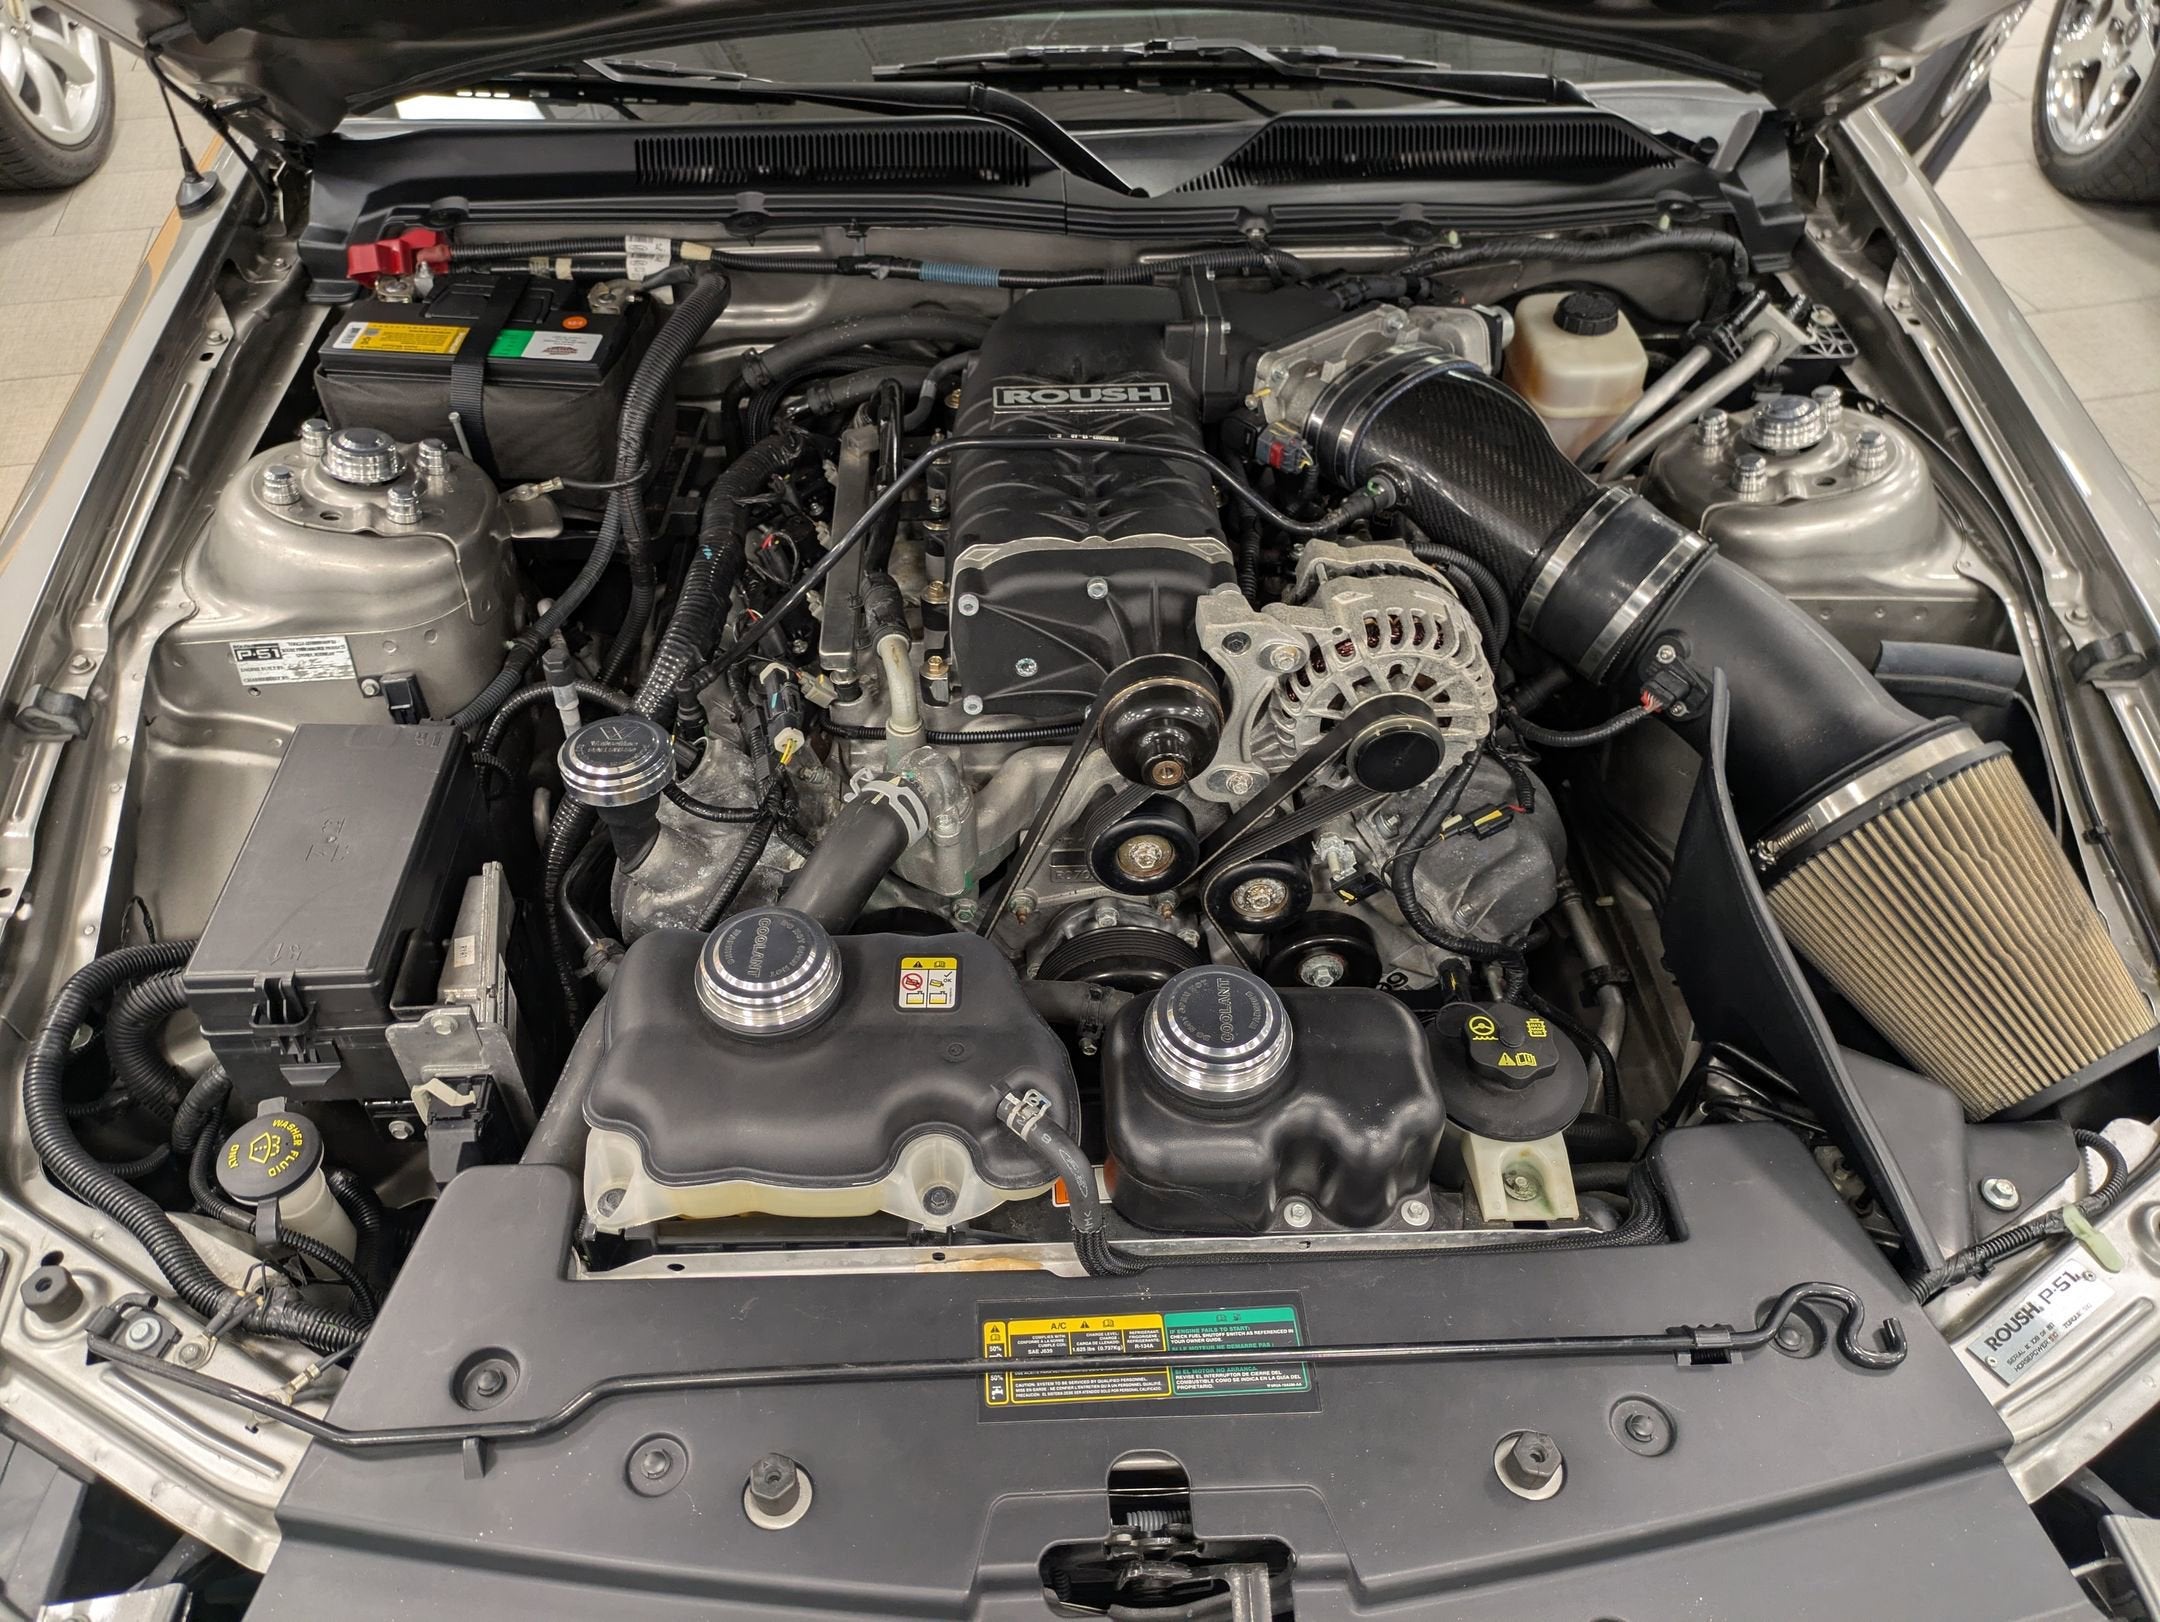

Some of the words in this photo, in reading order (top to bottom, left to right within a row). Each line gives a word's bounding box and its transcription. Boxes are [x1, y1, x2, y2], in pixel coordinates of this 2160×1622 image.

[1003, 387, 1162, 404] ROUSH
[748, 918, 772, 978] COOLANT
[1216, 978, 1234, 1044] COOLANT
[272, 1120, 302, 1146] WASHER
[228, 1144, 240, 1168] ONLY
[268, 1150, 300, 1177] FLUID
[1984, 1302, 2040, 1352] ROUSH
[2006, 1350, 2026, 1366] SERIAL
